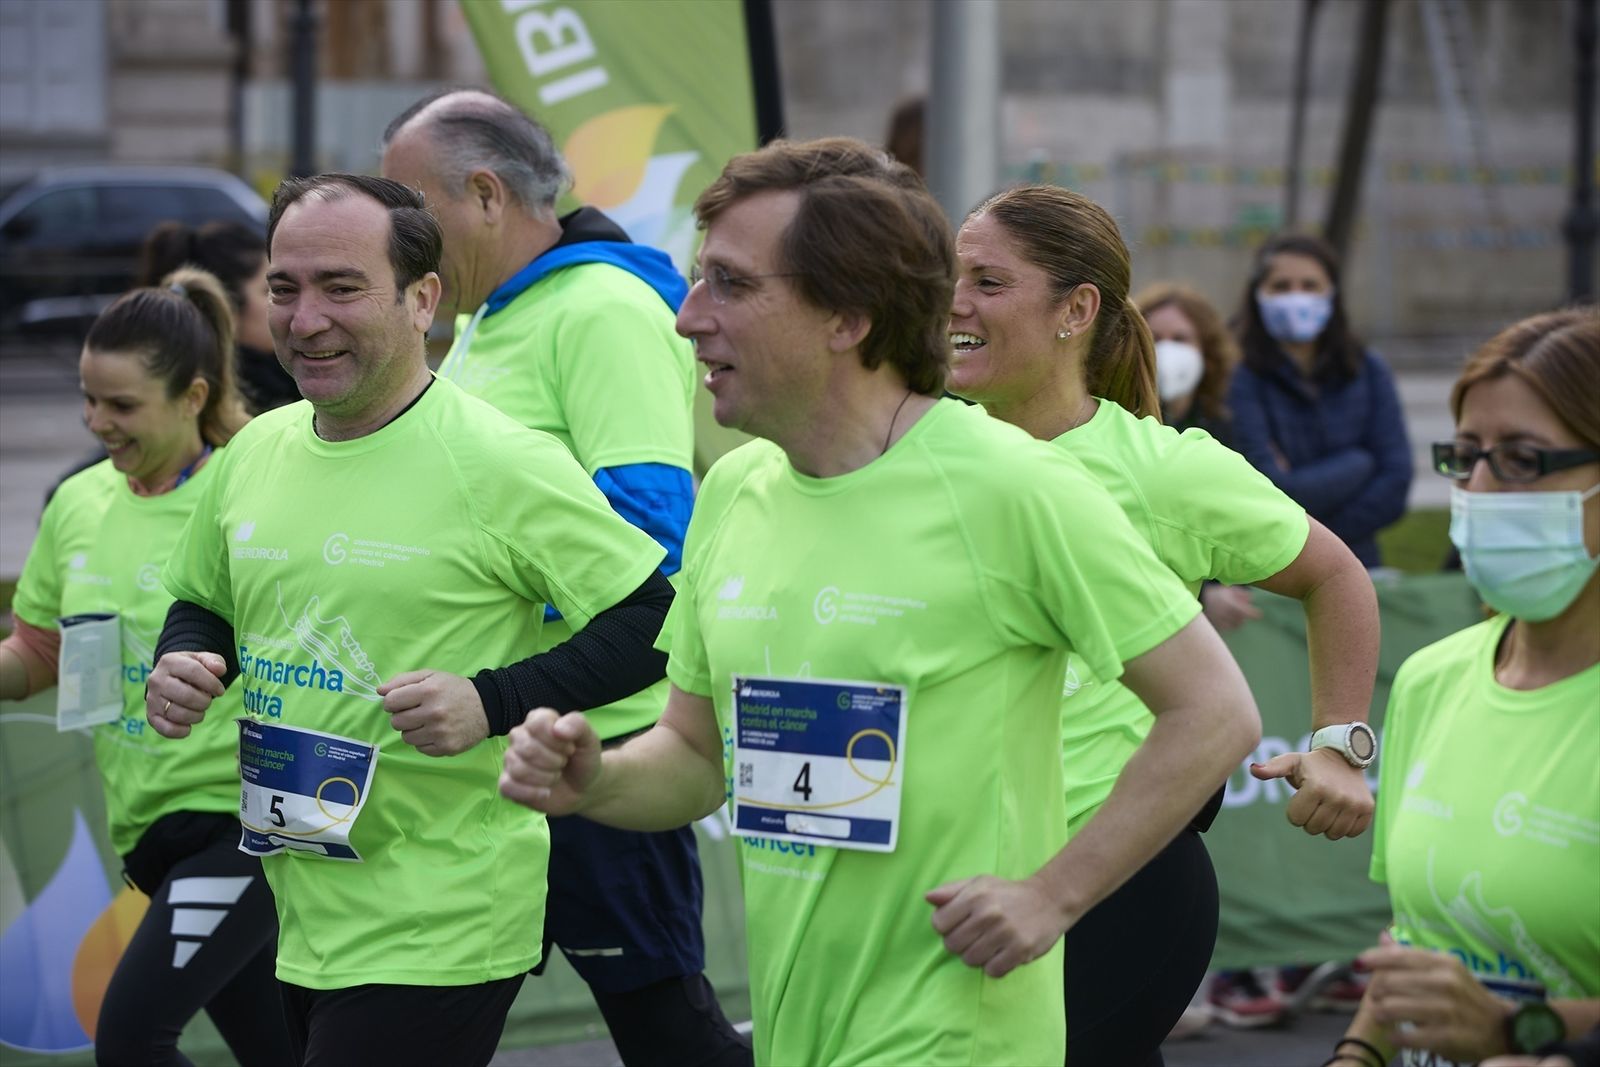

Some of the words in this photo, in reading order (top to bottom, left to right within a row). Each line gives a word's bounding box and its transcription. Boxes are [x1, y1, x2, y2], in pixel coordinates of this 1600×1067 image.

[504, 0, 608, 106] IB
[254, 659, 344, 692] marcha
[741, 702, 769, 716] Madrid
[771, 705, 783, 718] en
[784, 706, 817, 720] marcha
[741, 716, 767, 728] contra
[769, 716, 777, 728] el
[260, 756, 285, 771] cáncer
[264, 746, 295, 762] marcha
[793, 762, 812, 801] 4
[270, 795, 286, 828] 5
